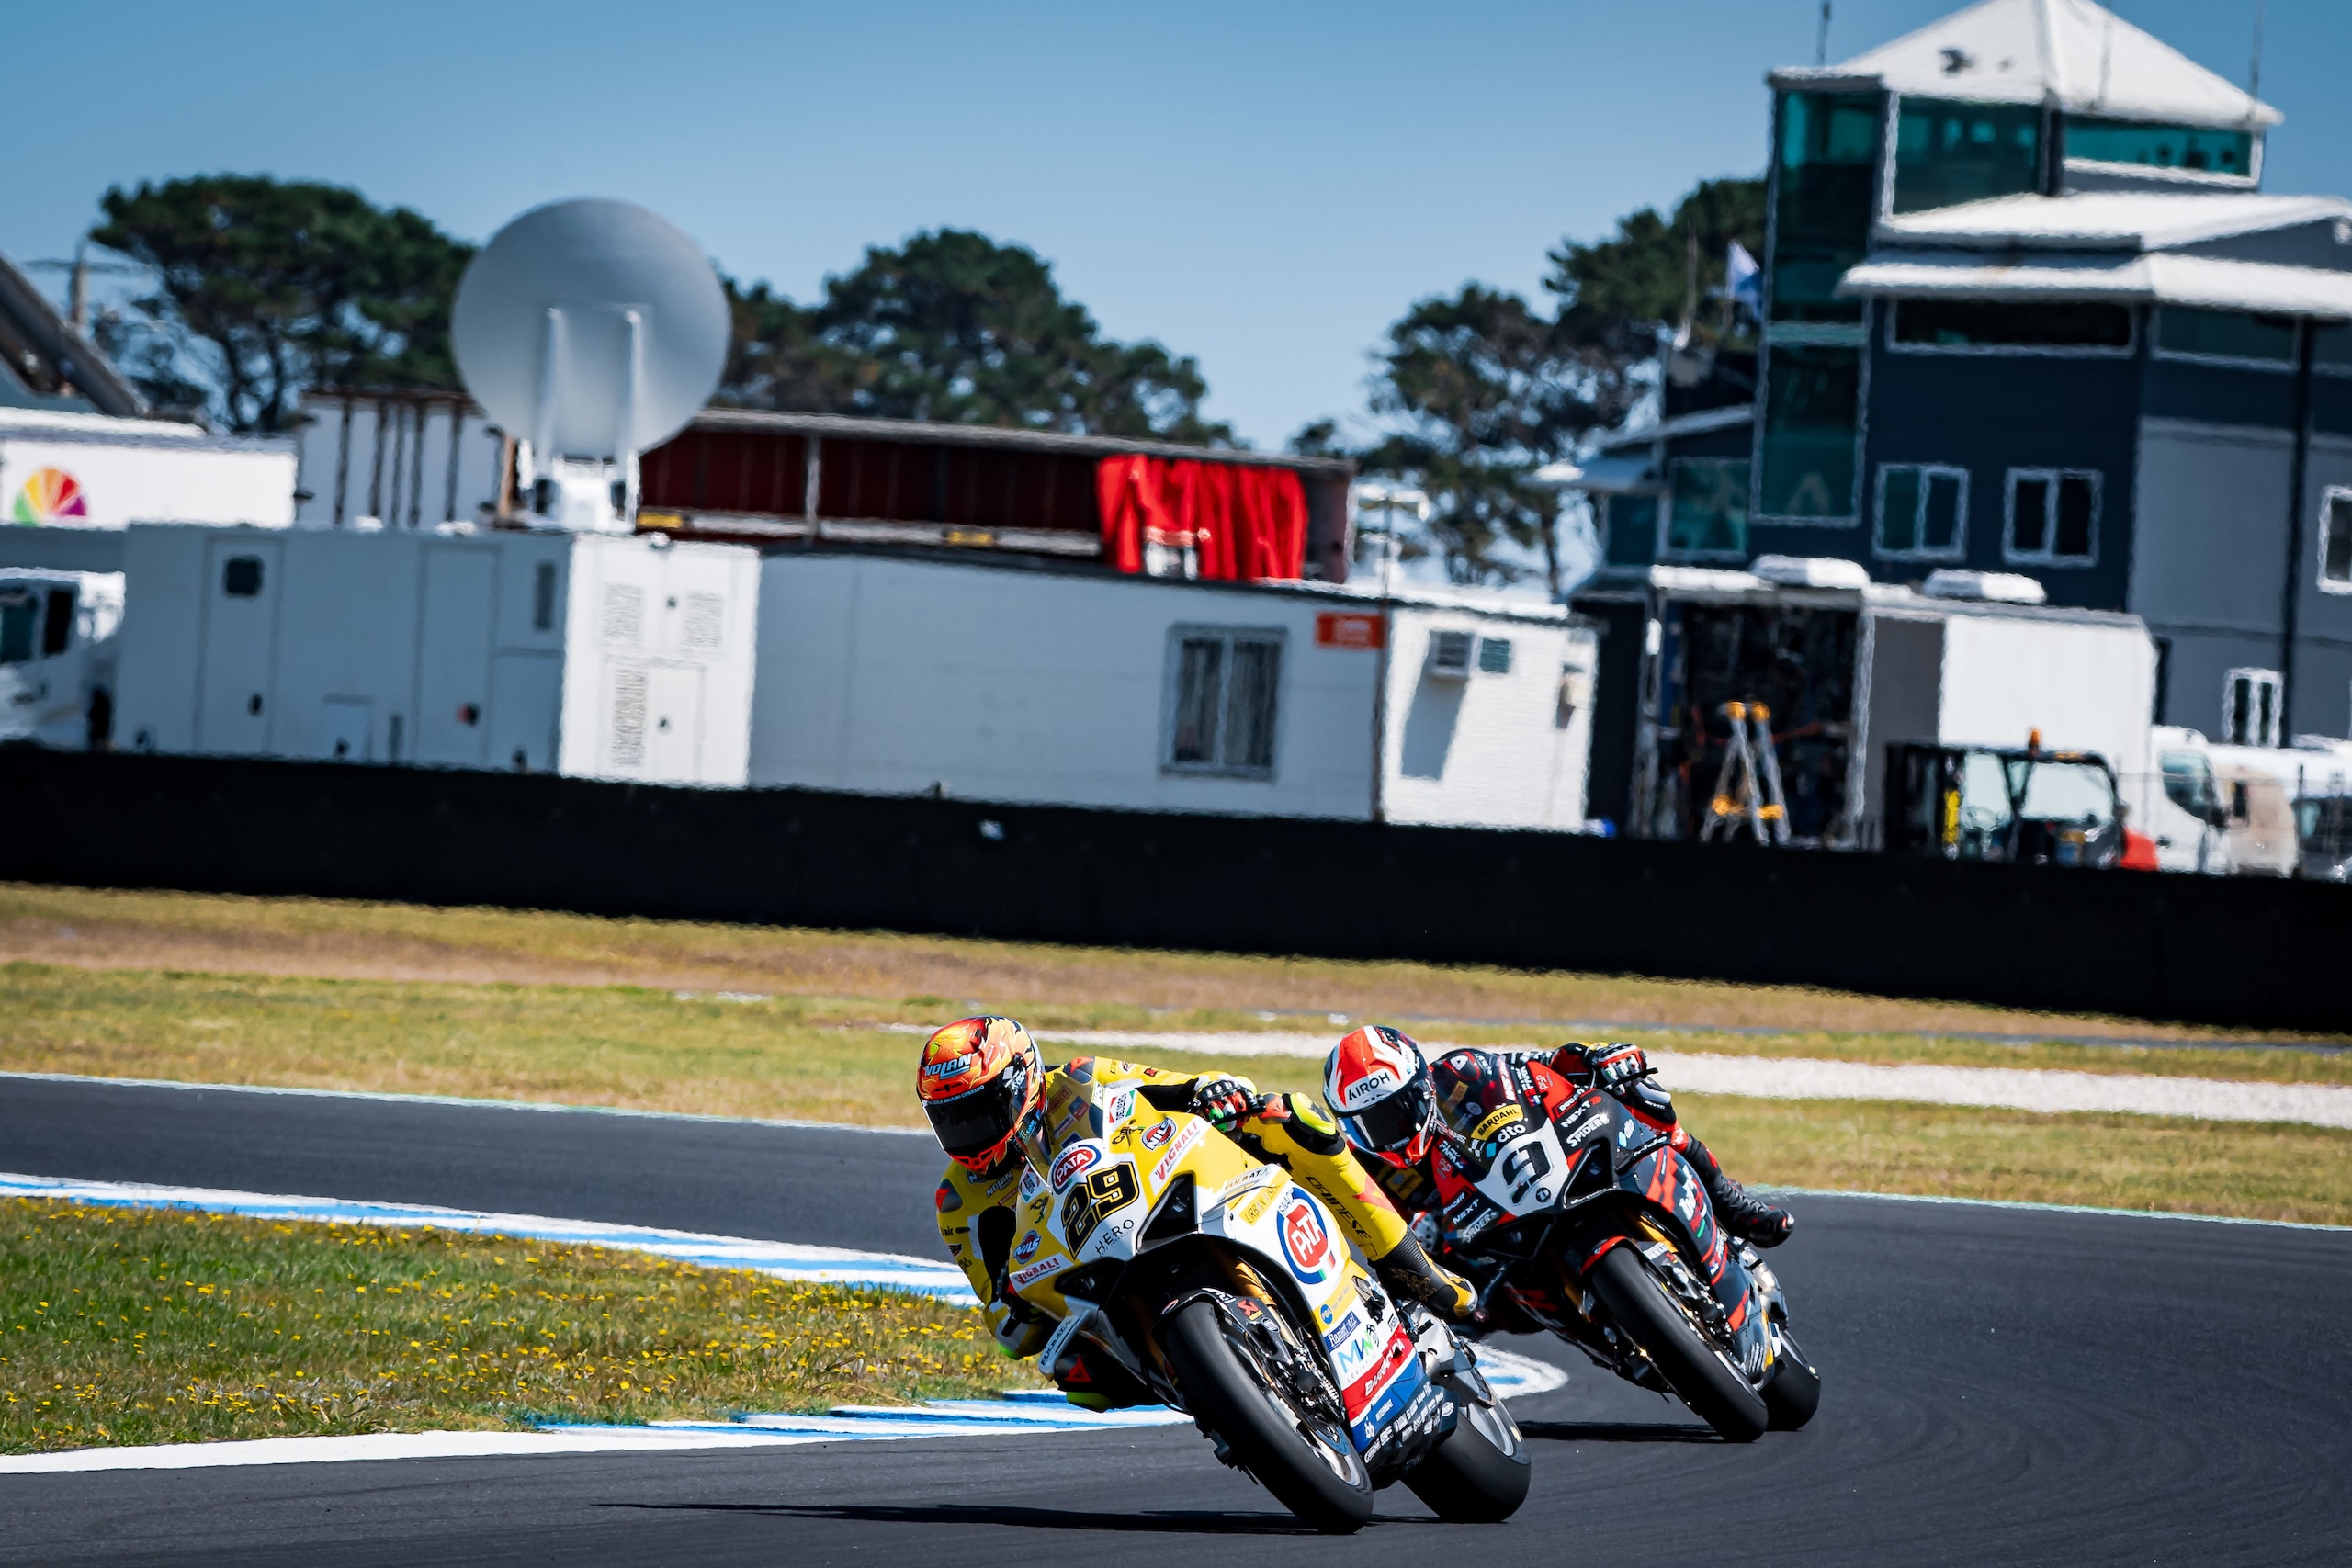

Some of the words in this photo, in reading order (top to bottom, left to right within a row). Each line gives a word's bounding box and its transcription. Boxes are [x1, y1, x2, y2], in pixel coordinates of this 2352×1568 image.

[924, 1053, 972, 1079] NOLAN
[1348, 1072, 1390, 1100] AIROH
[1477, 1108, 1520, 1136] BARDAHL
[1561, 1100, 1591, 1128] NEXT
[1145, 1117, 1172, 1150] NILS
[1498, 1124, 1526, 1143] dto
[1566, 1113, 1603, 1147] SPIDER
[1156, 1122, 1199, 1181] VIGNALI
[1056, 1152, 1090, 1182] PATA
[986, 1171, 1014, 1198] NOLAN
[1061, 1161, 1140, 1261] 29
[1306, 1176, 1372, 1239] DAINESE
[1453, 1198, 1479, 1225] NEXT
[1014, 1235, 1042, 1258] NILS
[1095, 1219, 1135, 1255] HERO
[1291, 1213, 1321, 1262] PATA
[1014, 1258, 1059, 1285] VIGNALI
